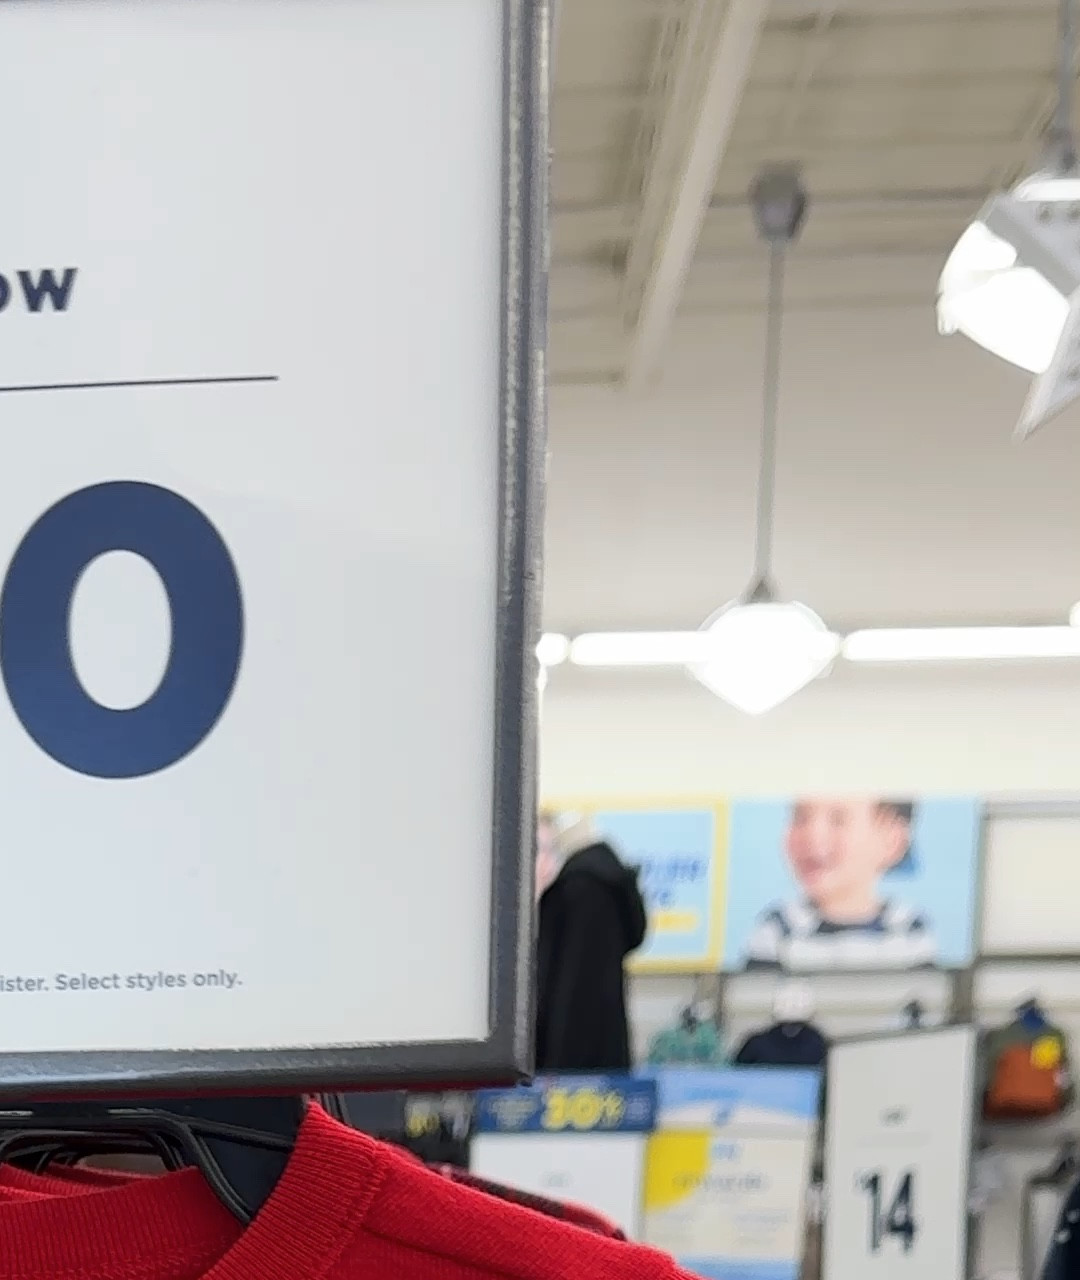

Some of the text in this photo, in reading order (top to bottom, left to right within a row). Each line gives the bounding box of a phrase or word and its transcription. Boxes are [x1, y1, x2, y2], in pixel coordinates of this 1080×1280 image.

[55, 972, 121, 991] Select
[125, 970, 188, 992] styles
[192, 968, 244, 989] only.
